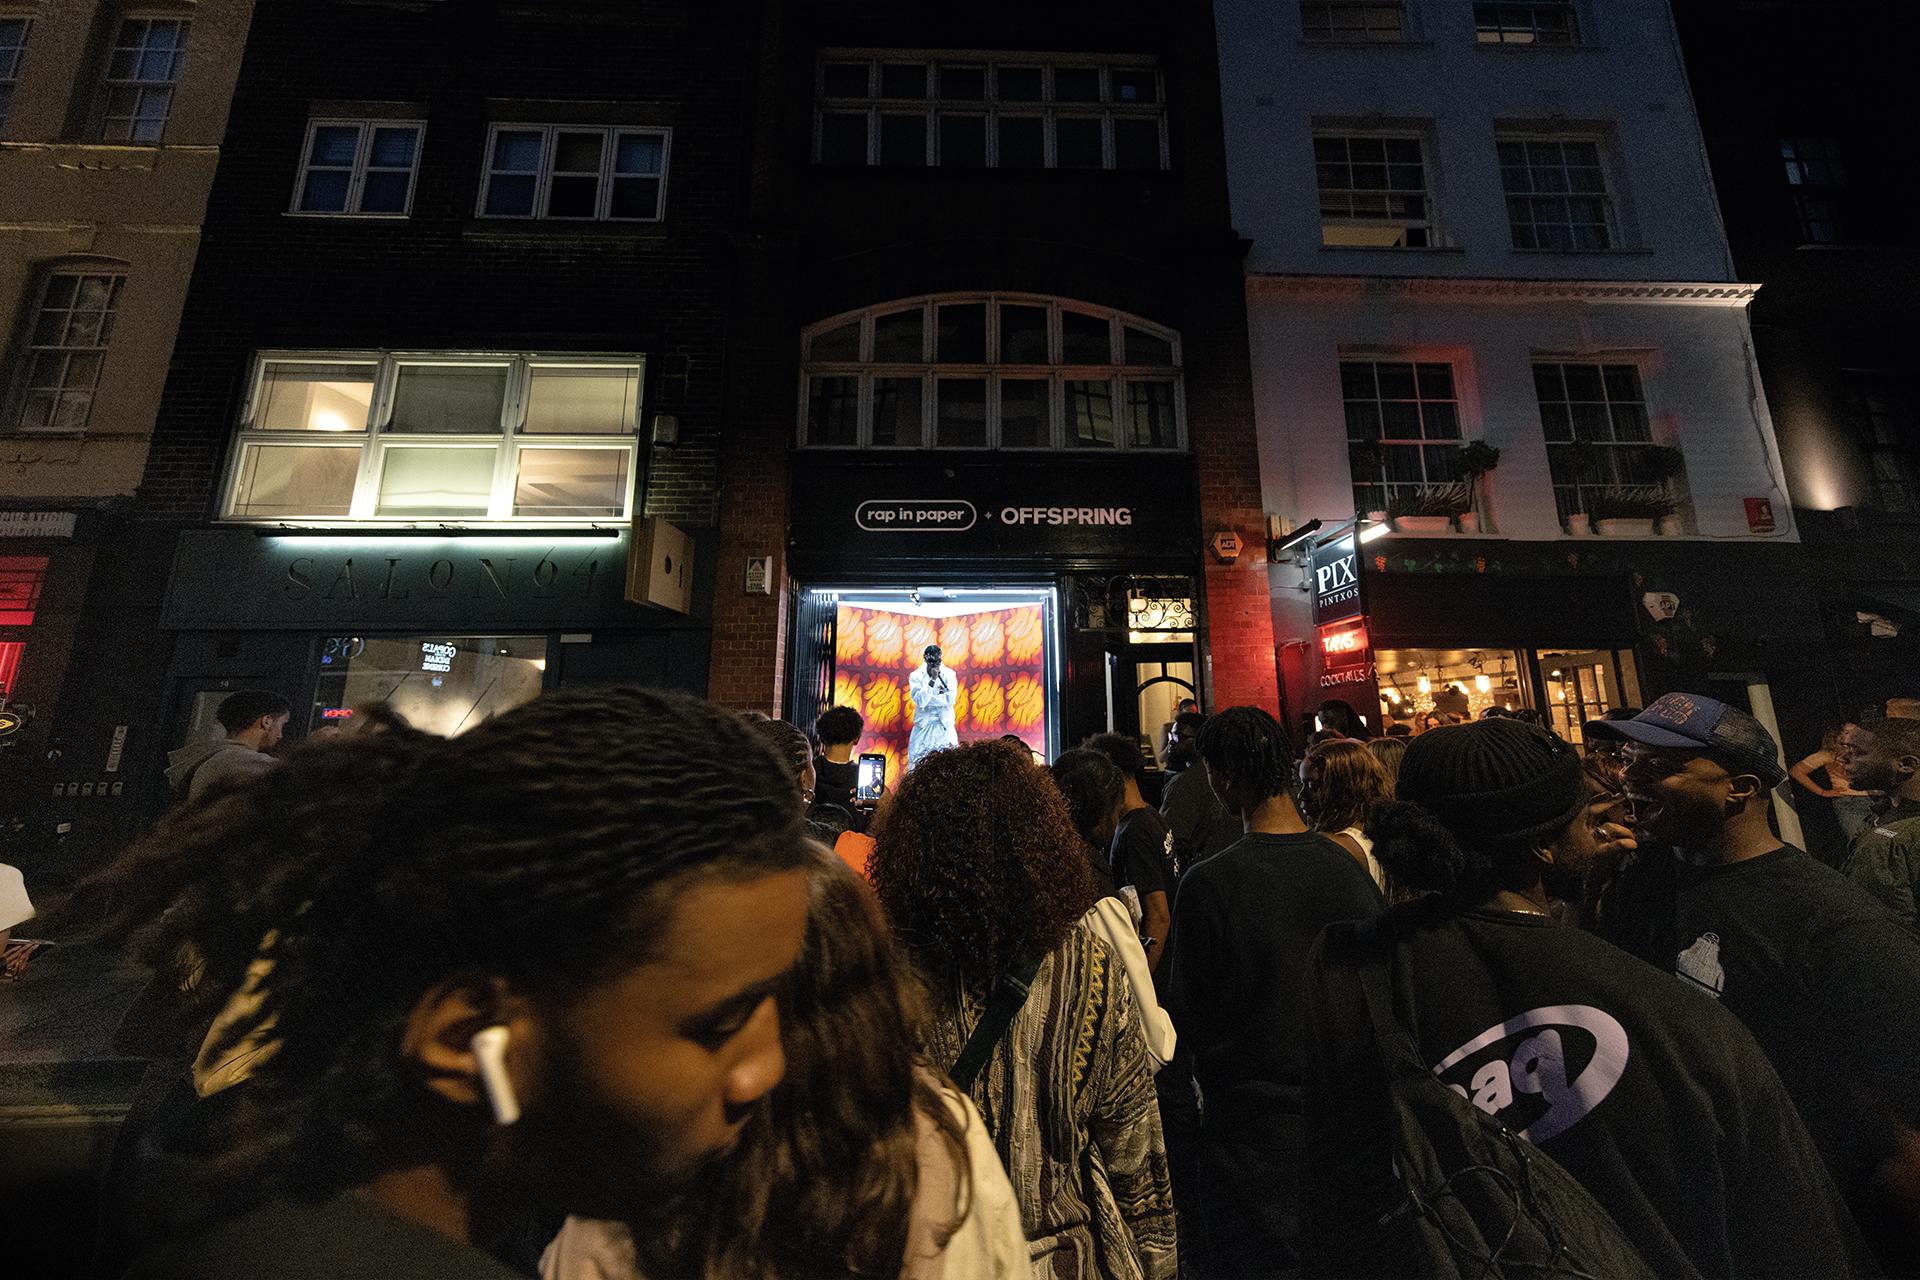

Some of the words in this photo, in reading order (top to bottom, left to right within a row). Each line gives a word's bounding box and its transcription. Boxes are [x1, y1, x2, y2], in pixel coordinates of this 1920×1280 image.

[867, 508, 896, 523] rap
[899, 506, 913, 521] in
[916, 508, 965, 523] paper
[1001, 506, 1132, 526] OFFSPRING
[1221, 539, 1235, 549] ADT
[1316, 554, 1357, 594] PIX
[1320, 587, 1359, 608] PINTXOS
[1320, 669, 1366, 687] COCKTAILS
